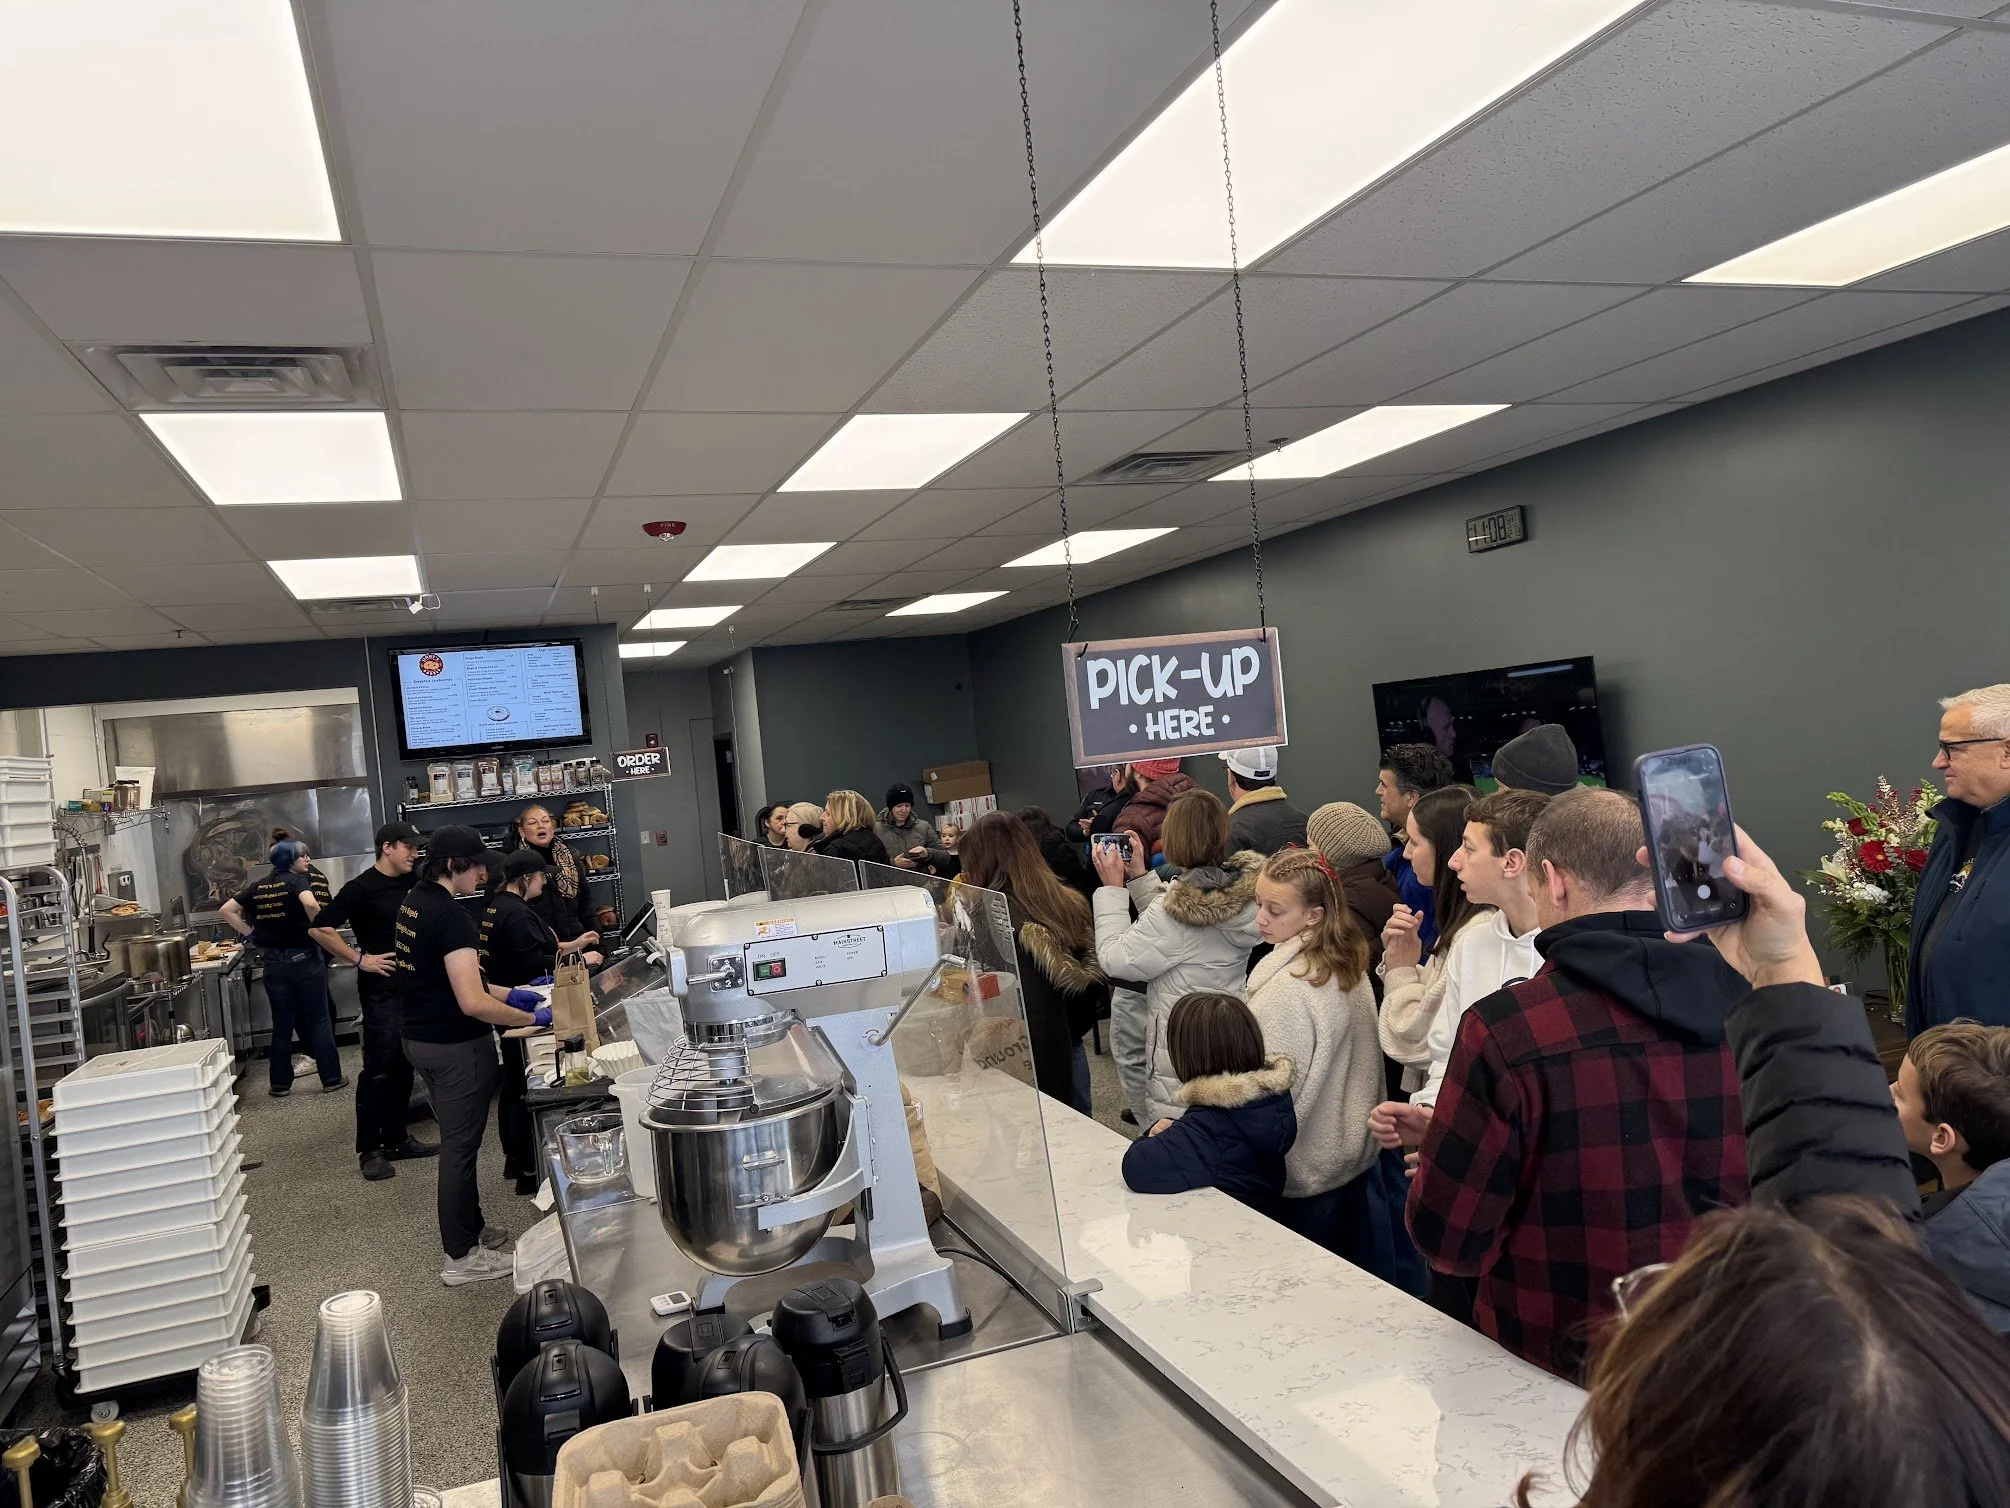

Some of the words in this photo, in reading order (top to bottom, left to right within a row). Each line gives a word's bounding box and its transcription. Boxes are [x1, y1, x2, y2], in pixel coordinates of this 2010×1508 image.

[1086, 645, 1260, 710] PICK-UP
[1145, 704, 1215, 741] HERE
[616, 752, 661, 768] ORDER
[630, 765, 651, 775] HERE
